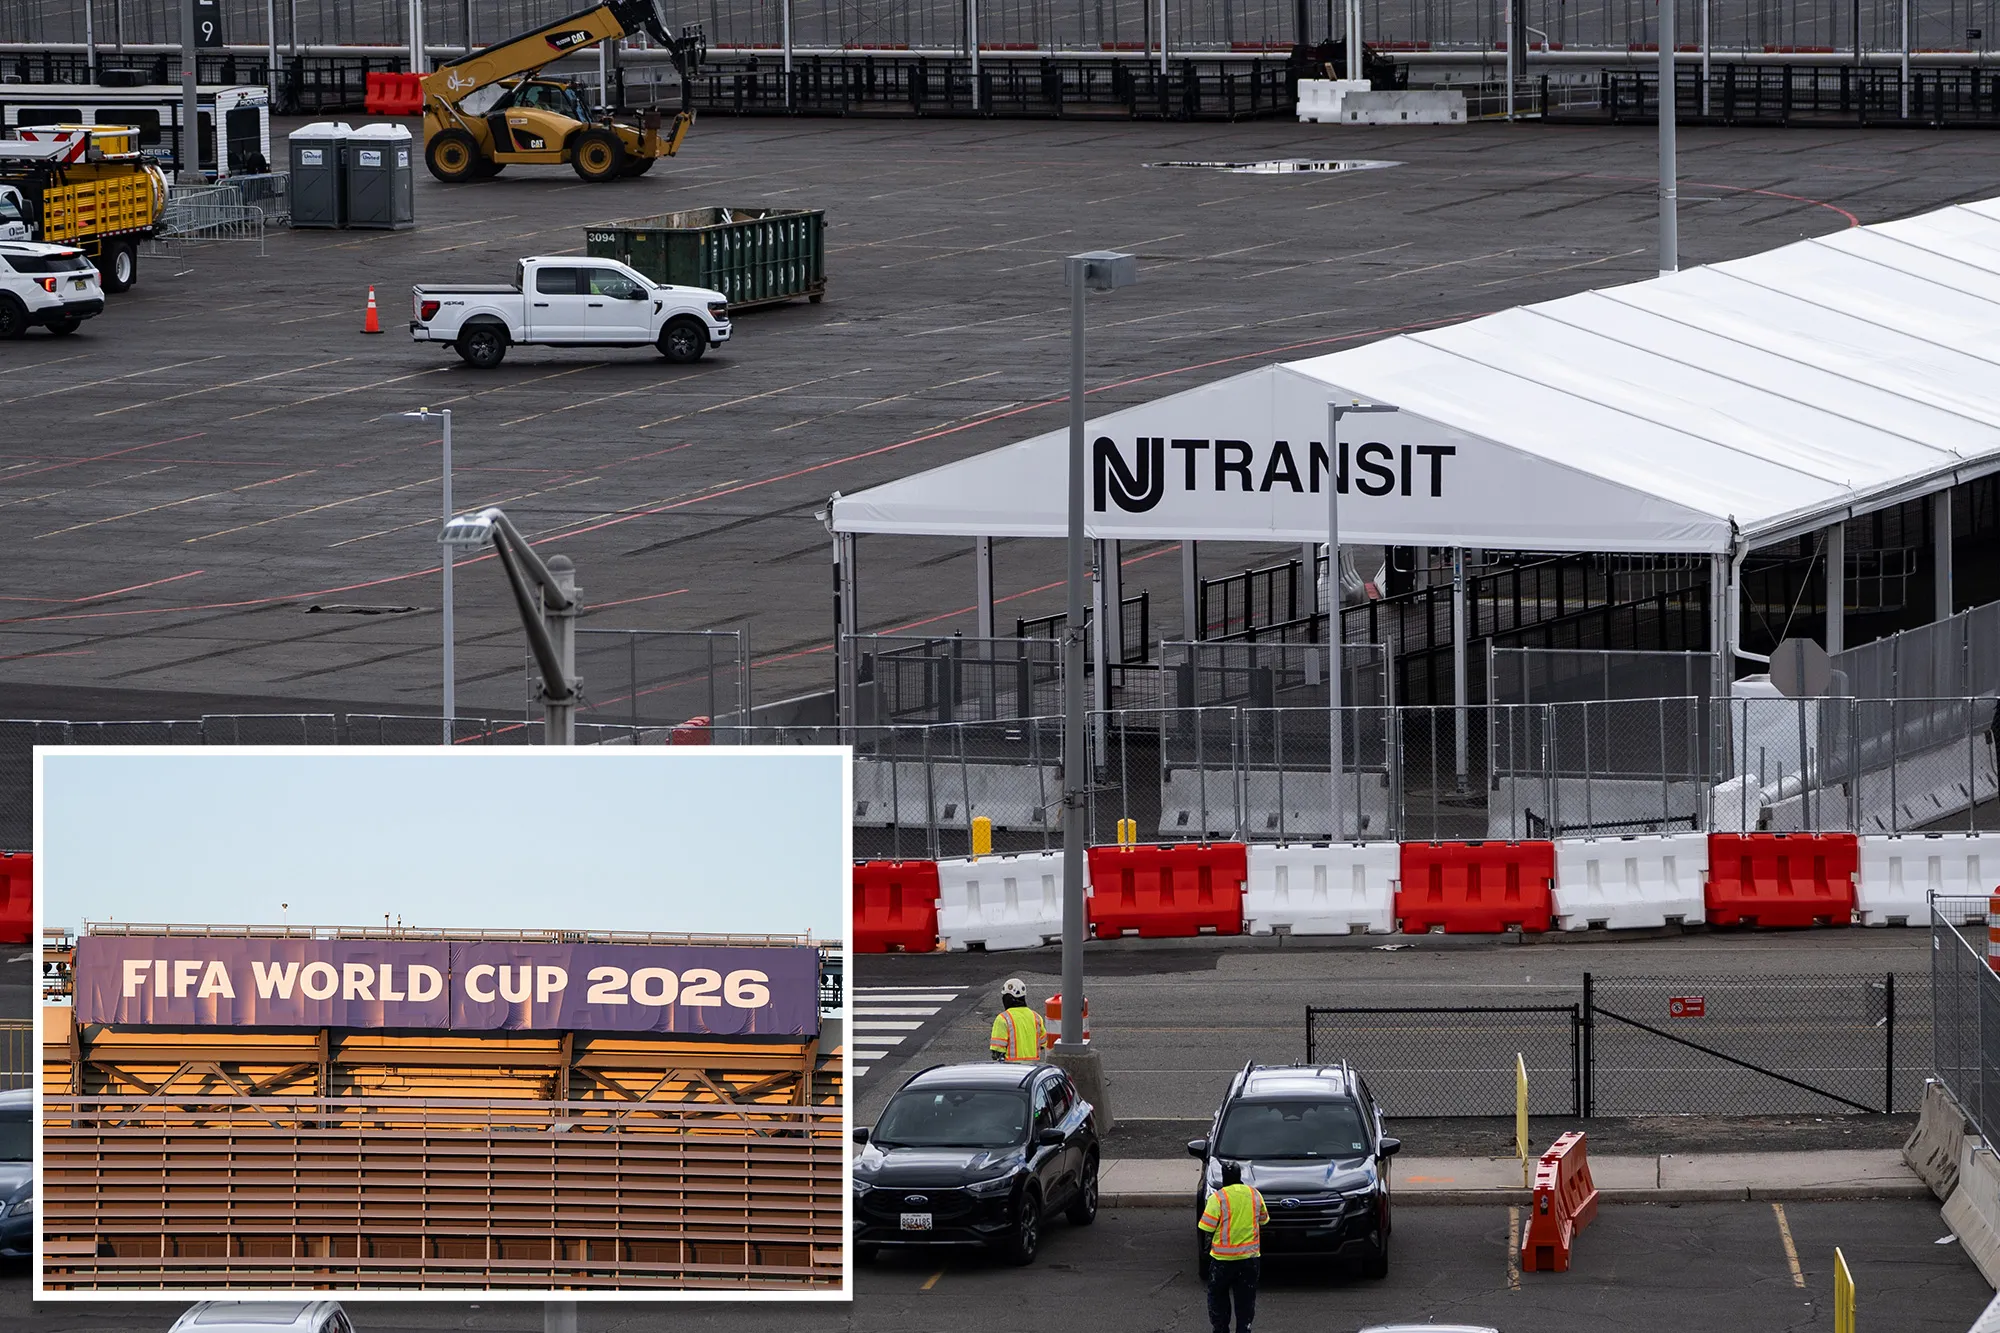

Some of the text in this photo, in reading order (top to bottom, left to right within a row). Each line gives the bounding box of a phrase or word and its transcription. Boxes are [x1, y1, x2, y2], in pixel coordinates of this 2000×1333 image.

[201, 21, 214, 42] 9
[571, 31, 586, 44] CAT
[239, 97, 269, 106] PIONEER
[530, 139, 544, 149] CAT
[588, 233, 616, 242] 3094
[1093, 436, 1457, 513] NJ TRANSIT
[122, 959, 771, 1009] FIFA WORLD CUP 2026
